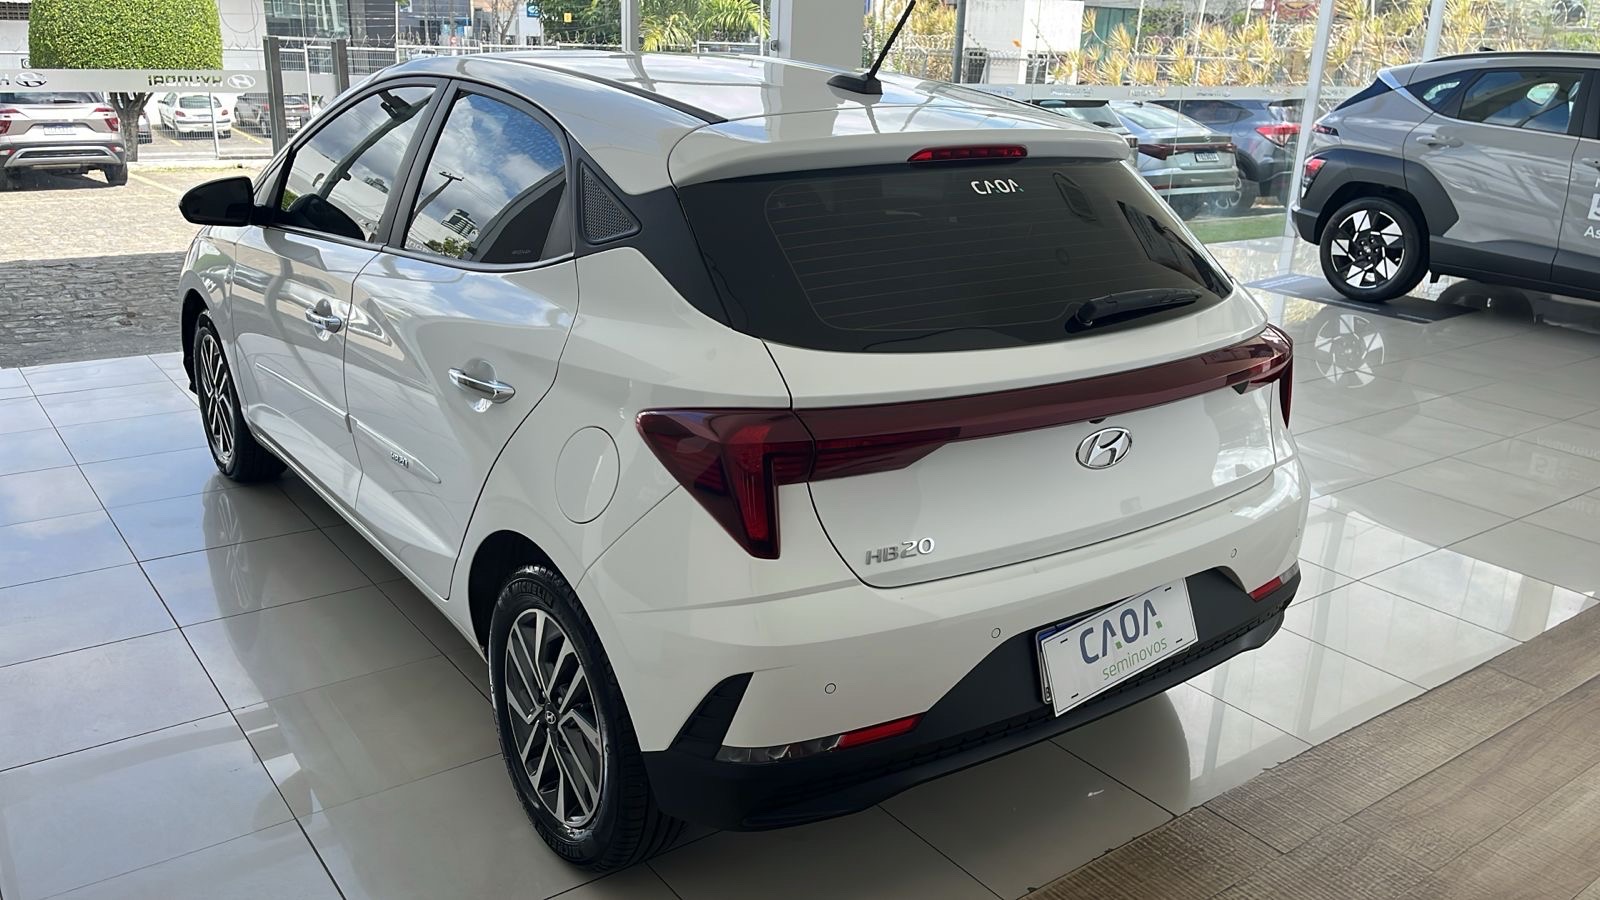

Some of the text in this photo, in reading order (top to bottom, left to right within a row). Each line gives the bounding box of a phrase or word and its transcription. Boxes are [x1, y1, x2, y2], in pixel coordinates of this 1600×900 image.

[971, 179, 1024, 194] CAOA
[865, 537, 935, 565] HB20
[1079, 599, 1163, 664] CAOA
[1102, 638, 1168, 680] seminovos
